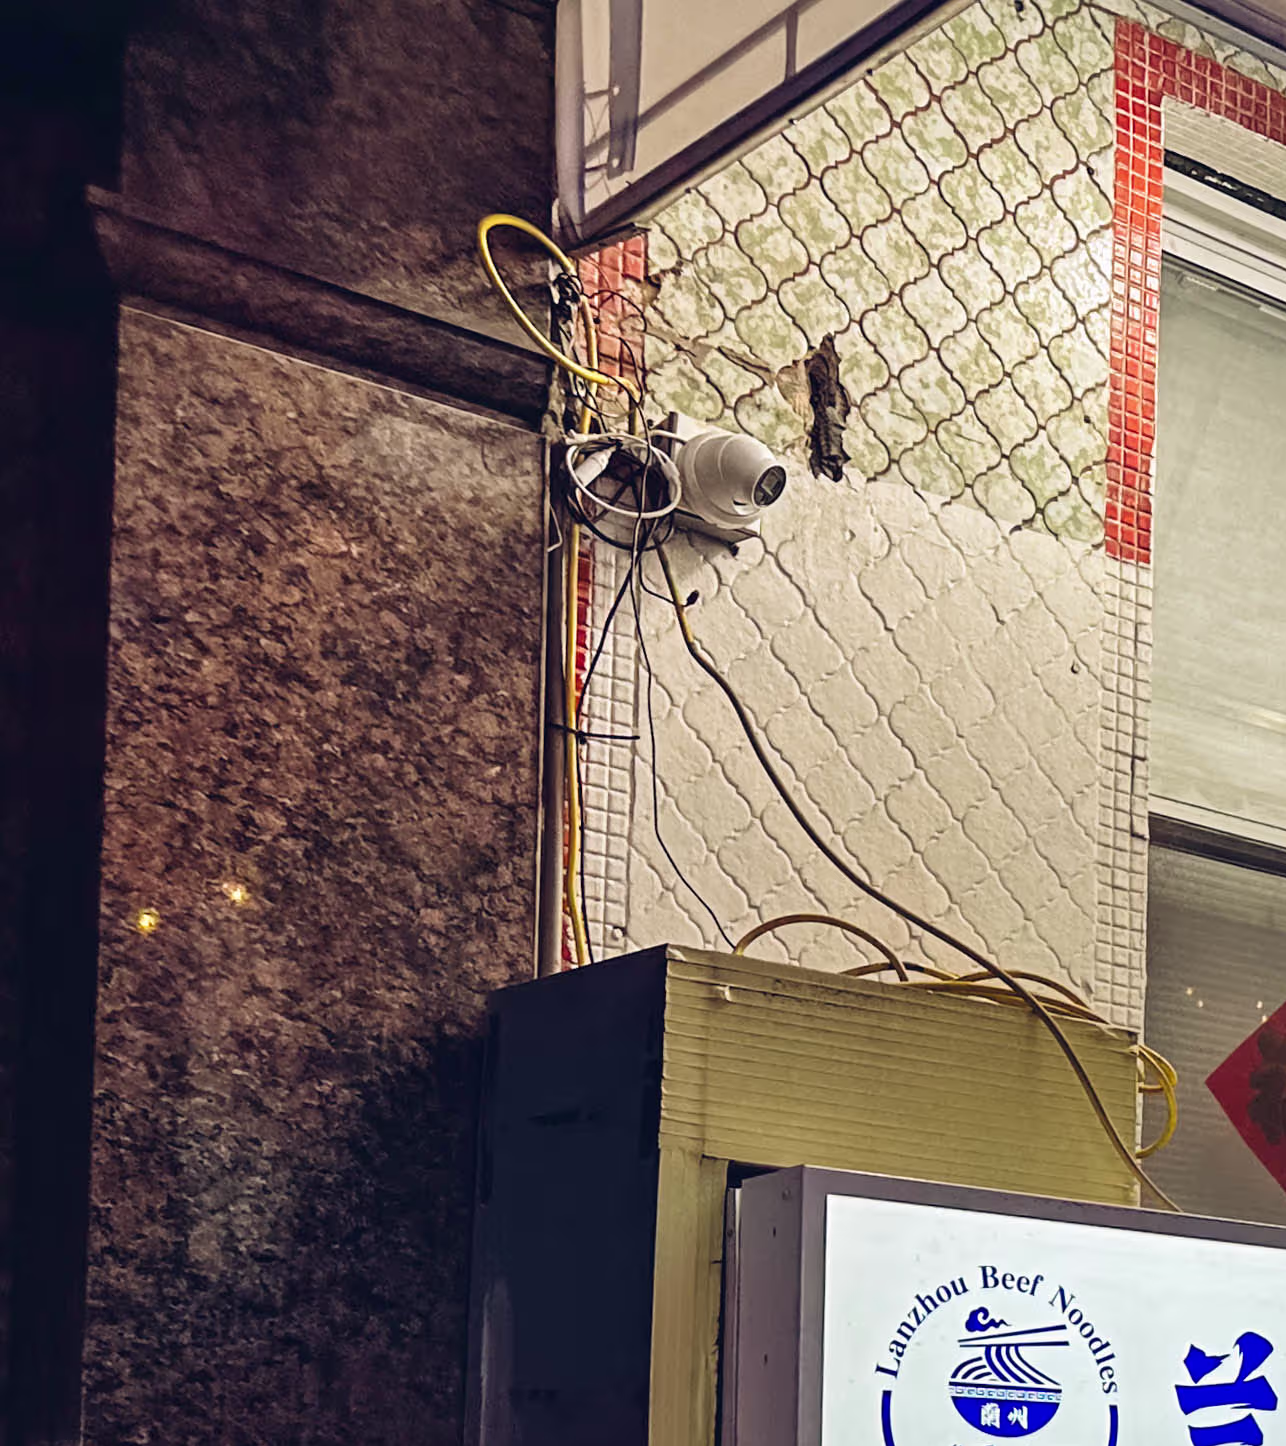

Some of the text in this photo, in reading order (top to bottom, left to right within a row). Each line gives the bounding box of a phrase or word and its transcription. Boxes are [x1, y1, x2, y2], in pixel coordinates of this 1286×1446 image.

[875, 1265, 1118, 1394] Lanzhou Beef Noodles
